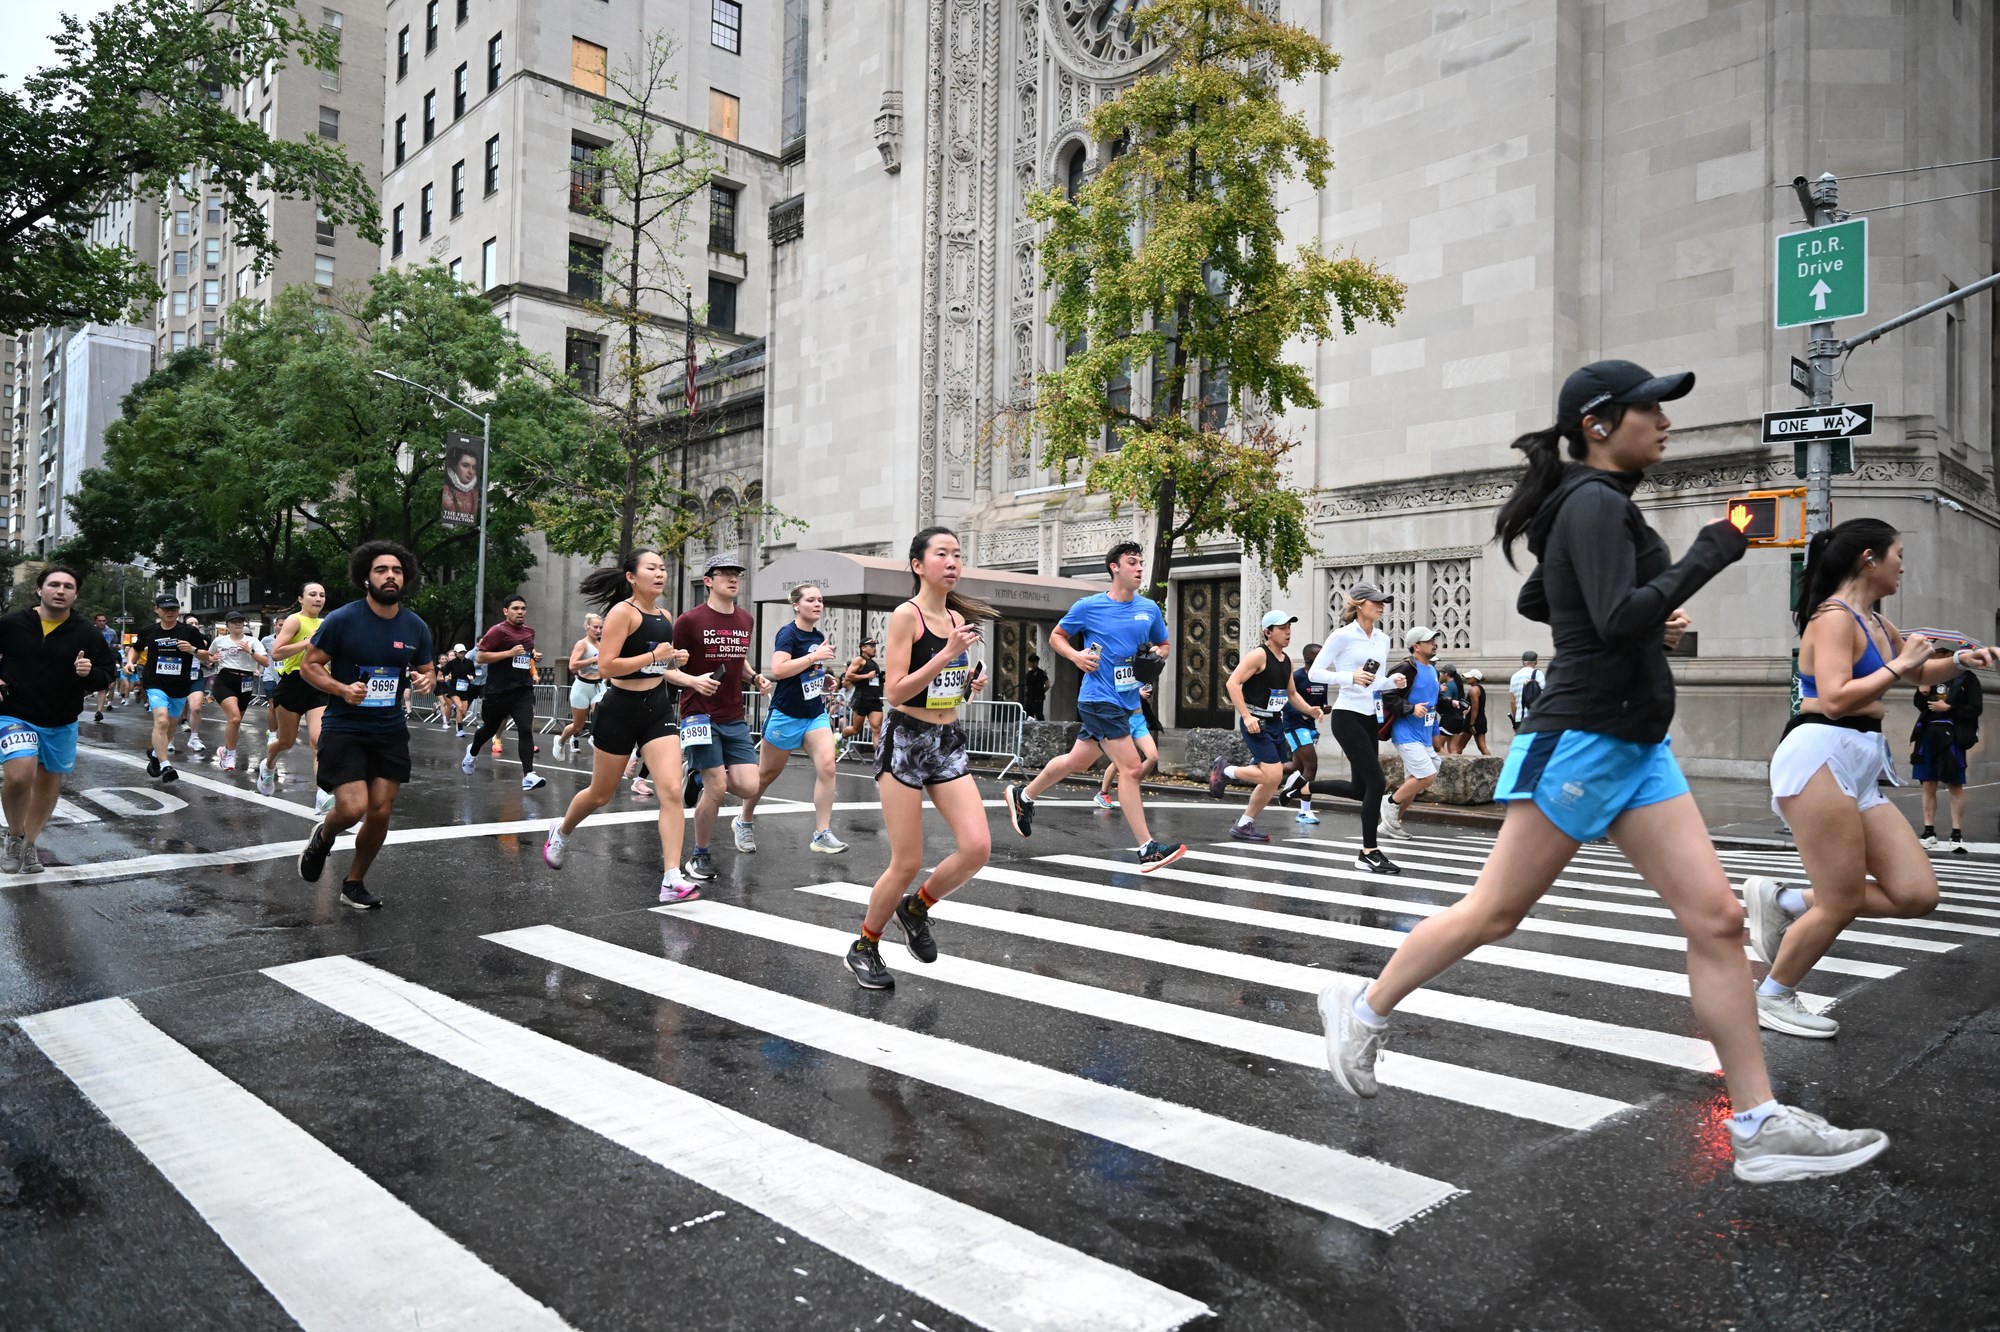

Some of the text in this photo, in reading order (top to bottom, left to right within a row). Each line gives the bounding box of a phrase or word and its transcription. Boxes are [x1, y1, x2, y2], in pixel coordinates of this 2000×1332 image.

[1797, 236, 1844, 258] F.D.R.
[1798, 259, 1843, 278] Drive
[1778, 415, 1856, 433] ONE WAY
[442, 514, 475, 523] COLLECTION
[456, 511, 475, 519] FRICK
[995, 588, 1050, 602] TEMPLE EMANU-EL
[703, 629, 749, 637] DC HALF
[726, 637, 740, 645] THE
[371, 679, 395, 692] 9696
[933, 669, 966, 688] G 5396
[686, 725, 708, 739] 9890
